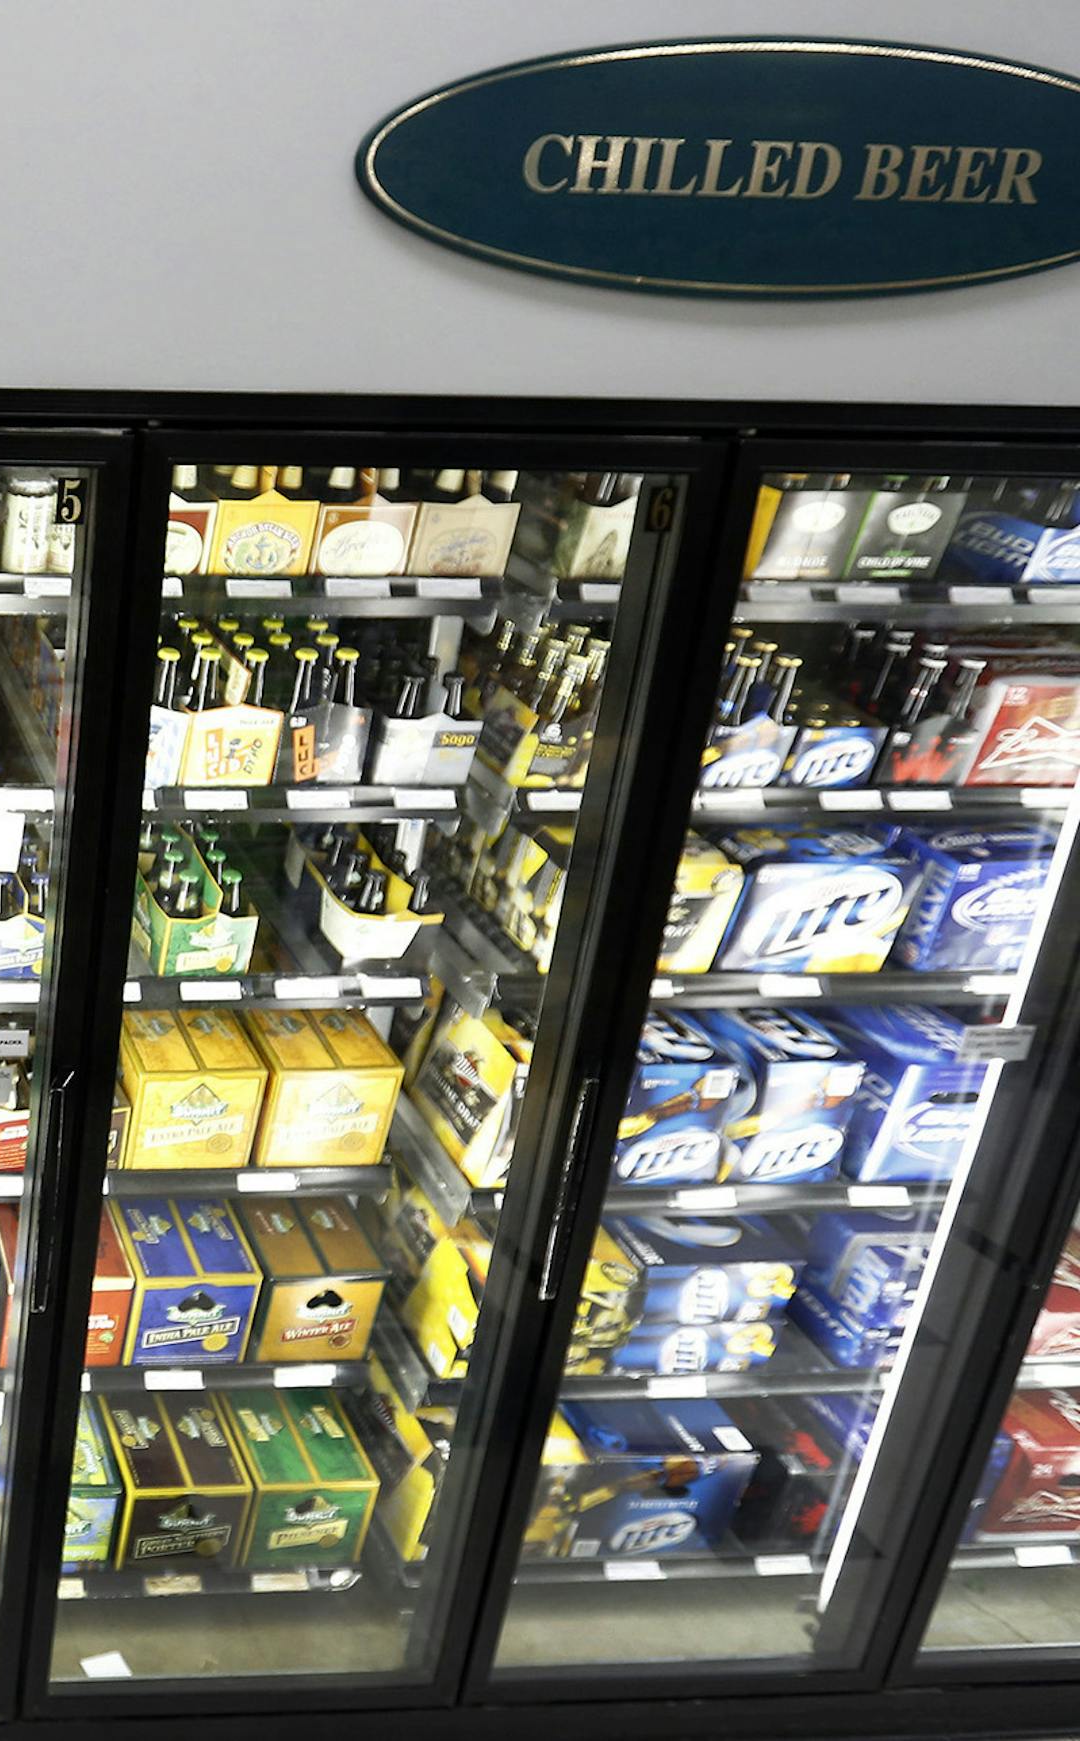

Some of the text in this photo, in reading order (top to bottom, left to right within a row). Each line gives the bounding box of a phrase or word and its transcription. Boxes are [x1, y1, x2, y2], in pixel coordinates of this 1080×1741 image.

[523, 133, 1043, 205] CHILLED BEER
[60, 479, 82, 522] 5
[651, 492, 672, 529] 6
[967, 520, 1037, 554] BUD
[147, 1321, 234, 1345] INDIA PALE ALE
[284, 1320, 354, 1341] WINTER ALE
[141, 1540, 196, 1554] PORTER
